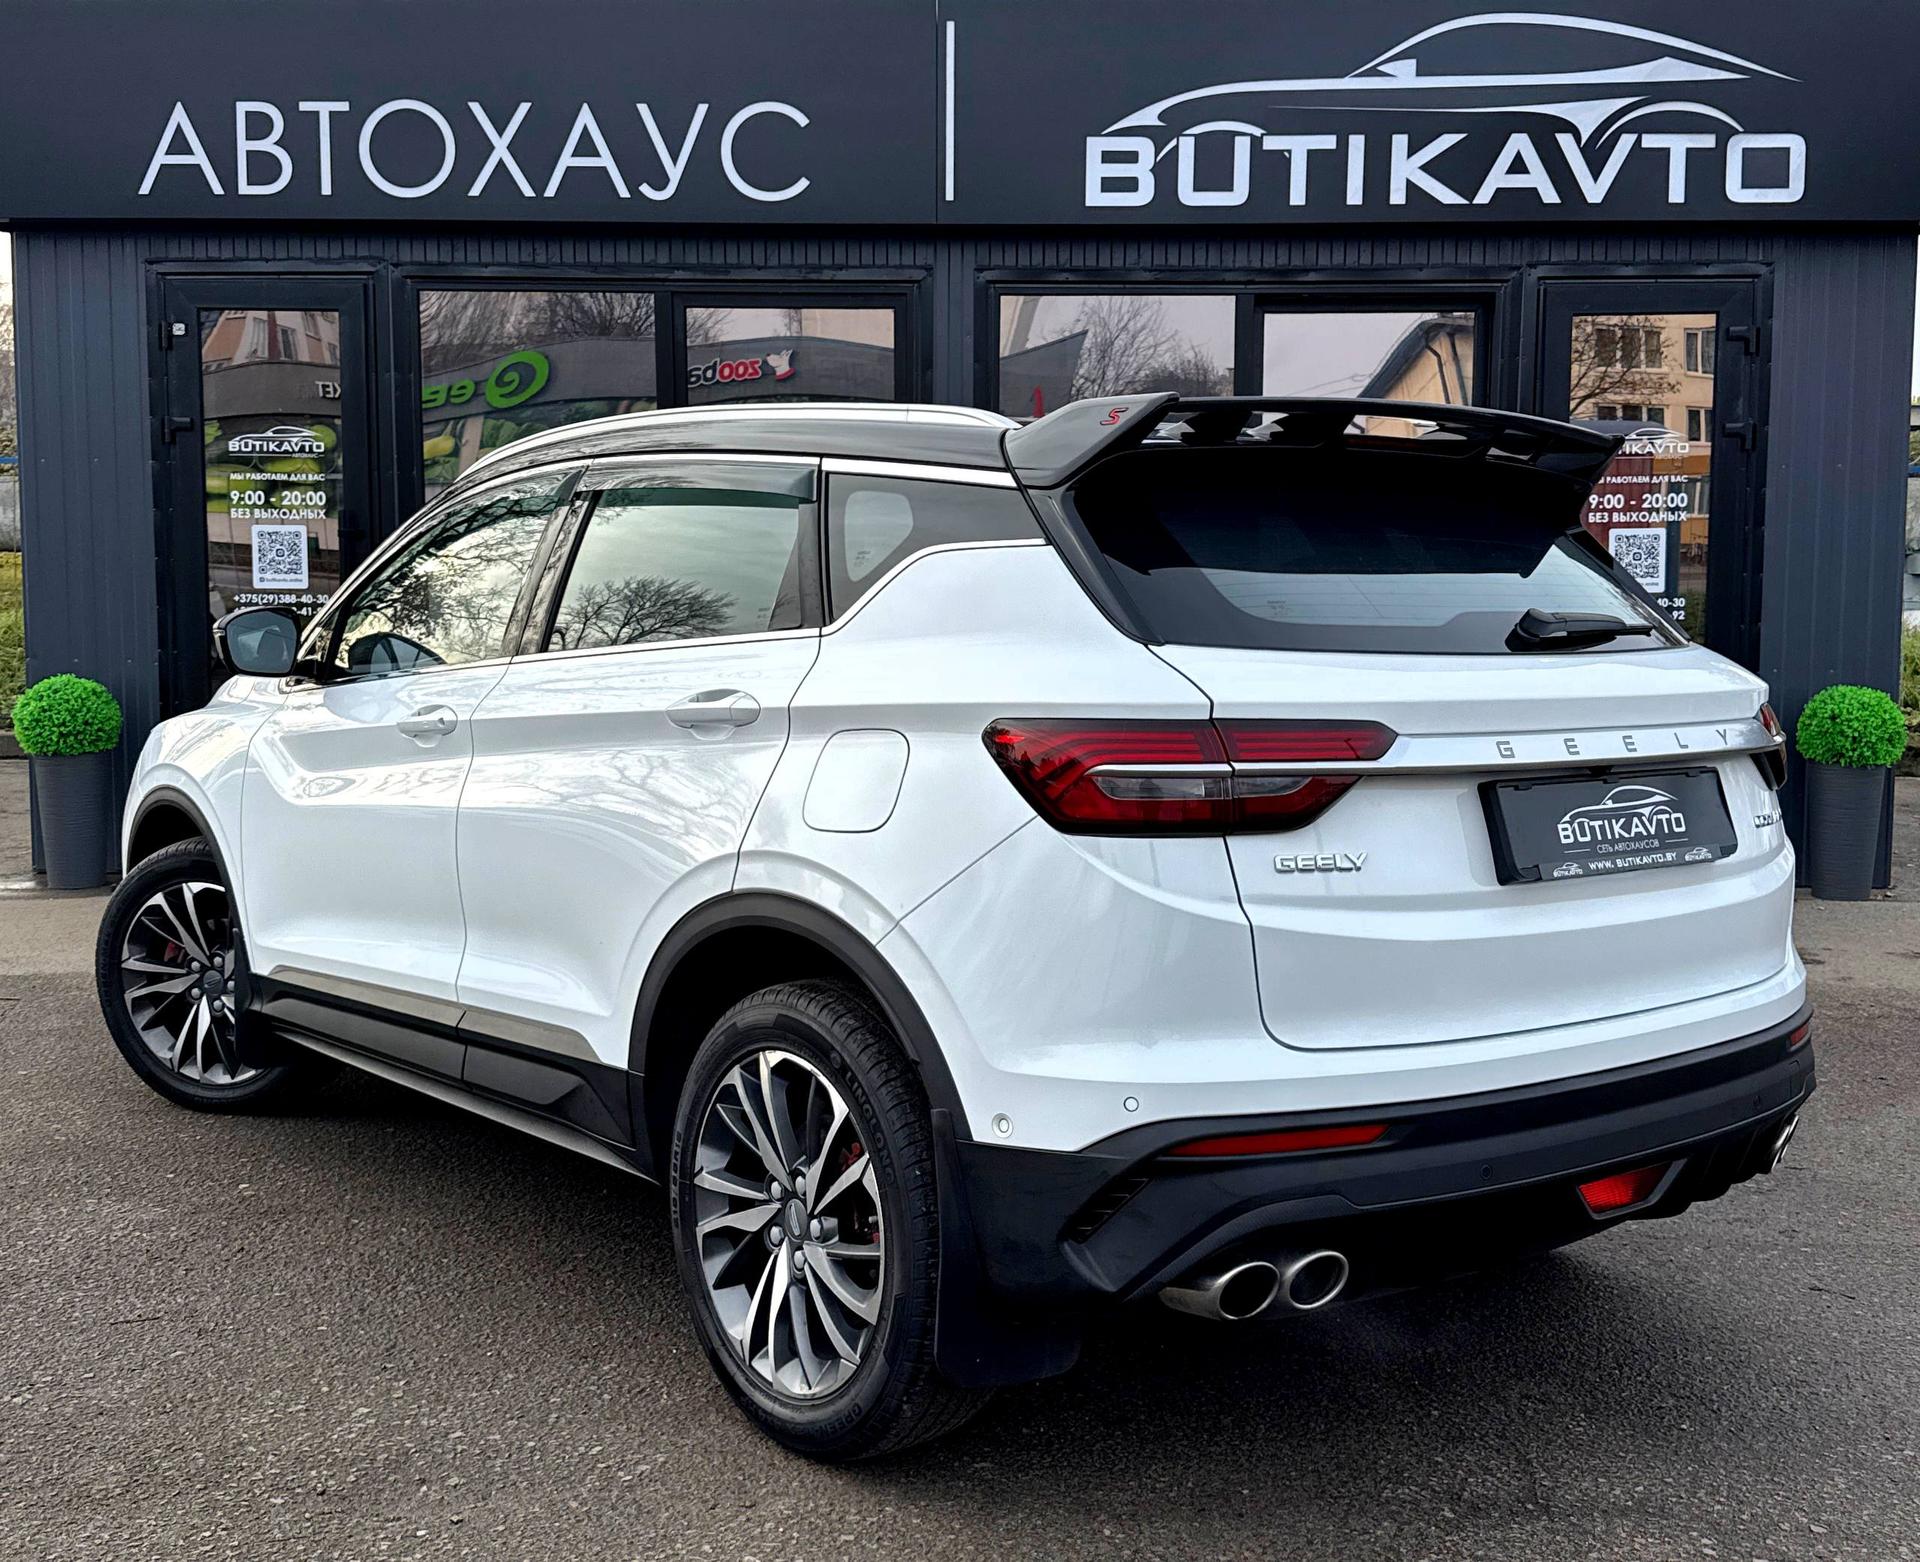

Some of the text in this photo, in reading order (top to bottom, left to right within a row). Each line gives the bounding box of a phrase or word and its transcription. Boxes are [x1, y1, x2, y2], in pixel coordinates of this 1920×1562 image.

[138, 99, 811, 203] АВТОХАУС
[1085, 133, 1807, 207] BUTIKAVTO
[228, 440, 325, 452] BUTIKAVTO
[246, 473, 288, 481] РАБОТАЕМ
[289, 473, 307, 481] ДЛЯ
[308, 473, 326, 481] ВАС
[1606, 475, 1650, 484] РАБОТАЕМ
[1651, 475, 1668, 483] ДЛЯ
[1670, 475, 1689, 483] ВАС
[230, 490, 265, 506] 9:00
[282, 490, 327, 506] 20:00
[1588, 494, 1624, 509] 9:00
[1641, 493, 1688, 508] 20:00
[230, 508, 327, 520] БЕЗ ВЫХОДНЫХ
[1588, 511, 1688, 523] БЕЗ ВЫХОДНЫХ
[233, 593, 330, 605] +375(29)388-40-30
[1496, 728, 1729, 759] GEELY
[1557, 812, 1687, 844] BUTIKAVTO
[1614, 838, 1660, 852] АВТОХАУСОВ
[1274, 852, 1368, 874] GEELY
[1616, 852, 1678, 867] BUTIKAVTO.BY
